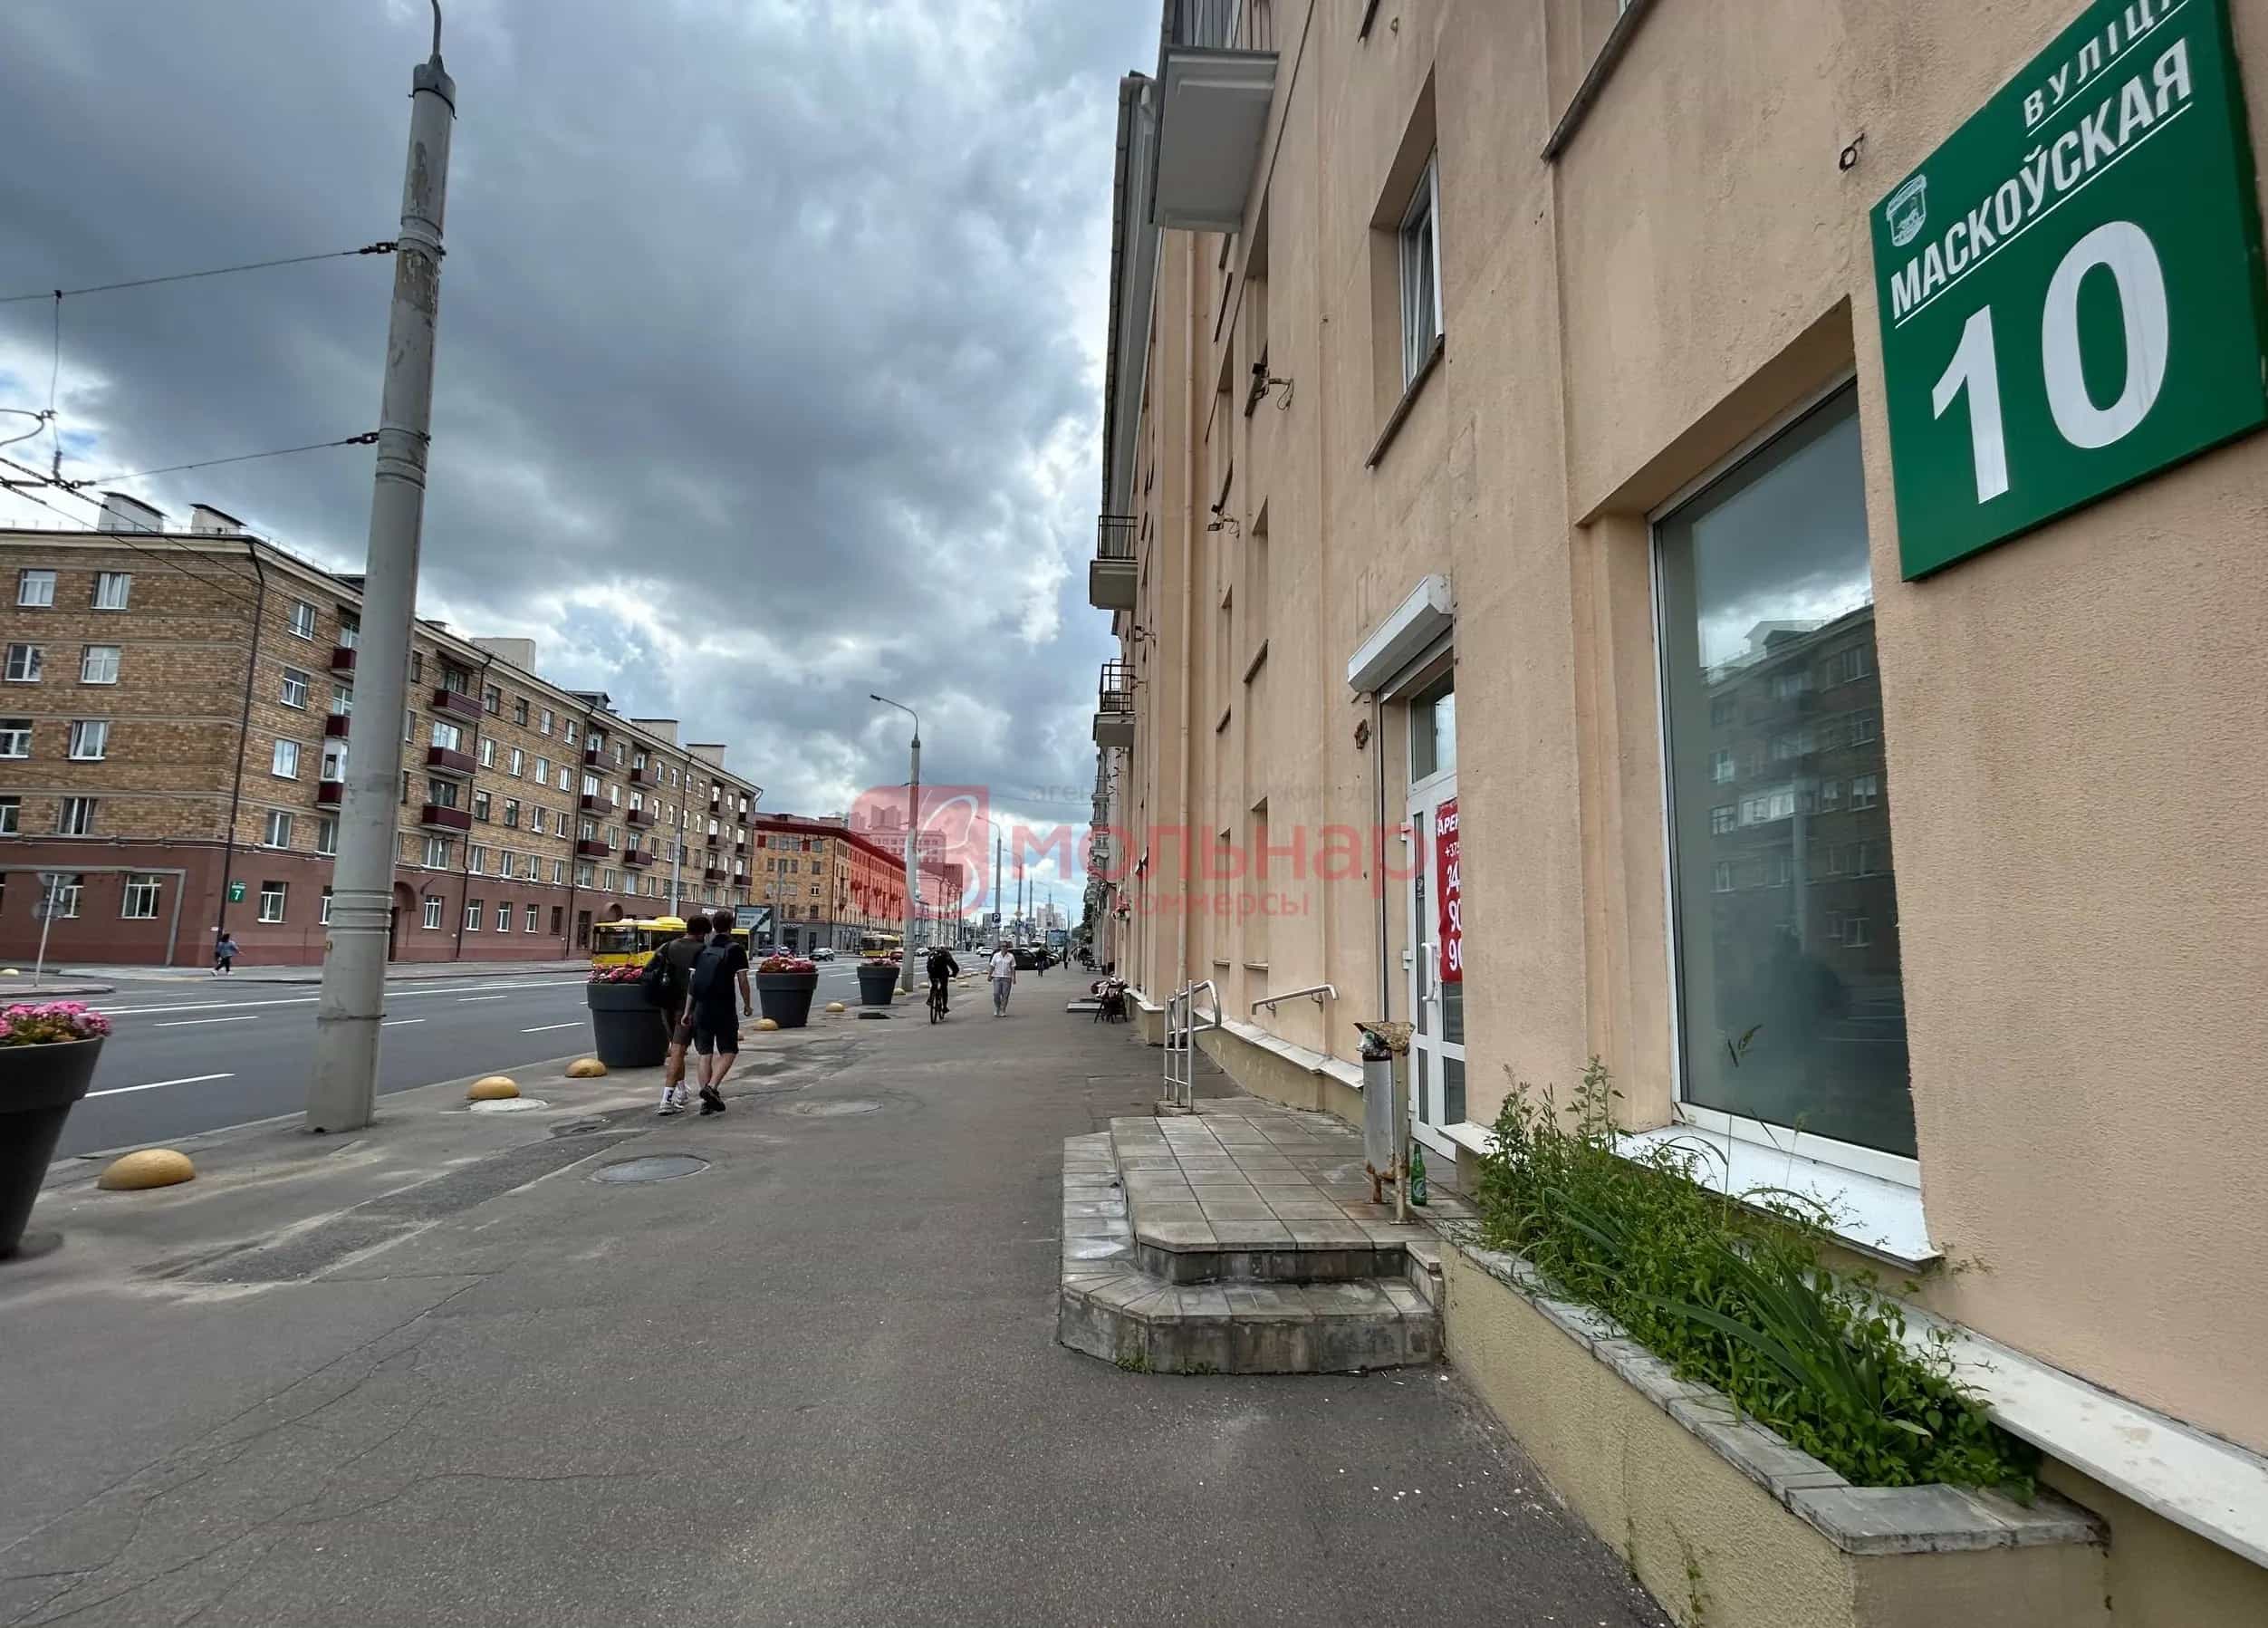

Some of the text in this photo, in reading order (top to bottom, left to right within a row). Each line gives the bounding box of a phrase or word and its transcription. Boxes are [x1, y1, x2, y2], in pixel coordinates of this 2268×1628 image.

[1890, 37, 2192, 320] МАСКОЎСКАЯ
[1932, 221, 2169, 505] 10
[235, 890, 242, 901] 7
